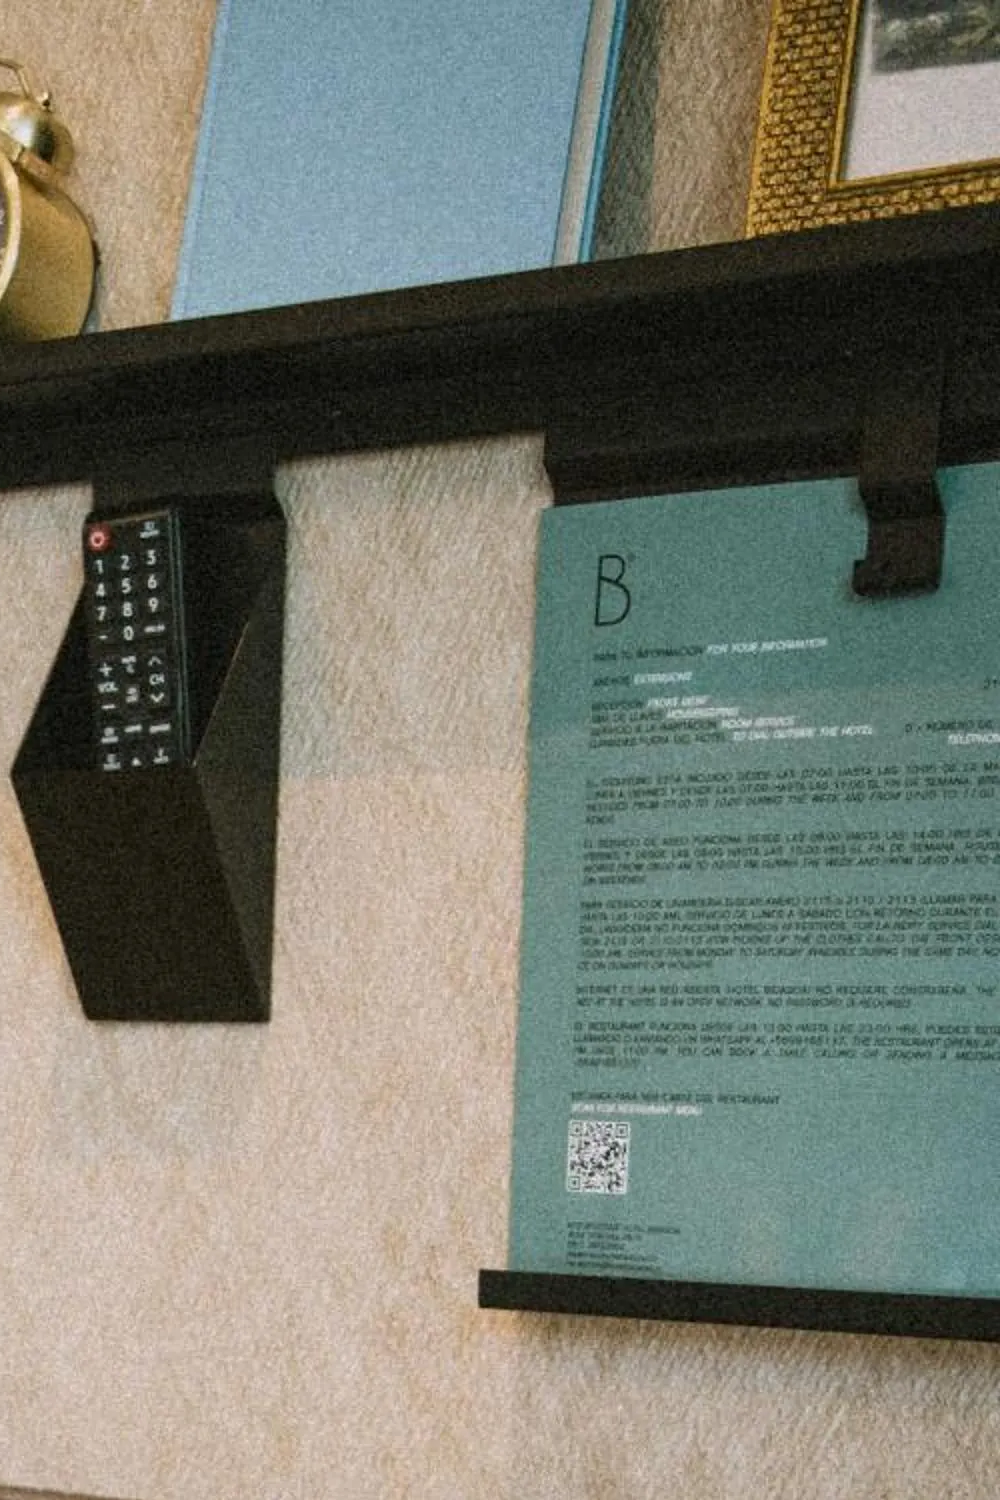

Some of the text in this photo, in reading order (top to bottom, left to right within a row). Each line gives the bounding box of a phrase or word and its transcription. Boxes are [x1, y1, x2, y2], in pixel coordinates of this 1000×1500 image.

[120, 555, 131, 571] 2
[146, 549, 157, 566] 3
[95, 559, 105, 575] 1
[121, 577, 133, 594] 5
[147, 573, 158, 589] 6
[96, 582, 106, 598] 4
[594, 553, 631, 626] B
[96, 605, 108, 621] 7
[122, 601, 133, 617] 8
[148, 597, 159, 613] 9
[123, 625, 134, 641] 0
[98, 681, 120, 693] VOL
